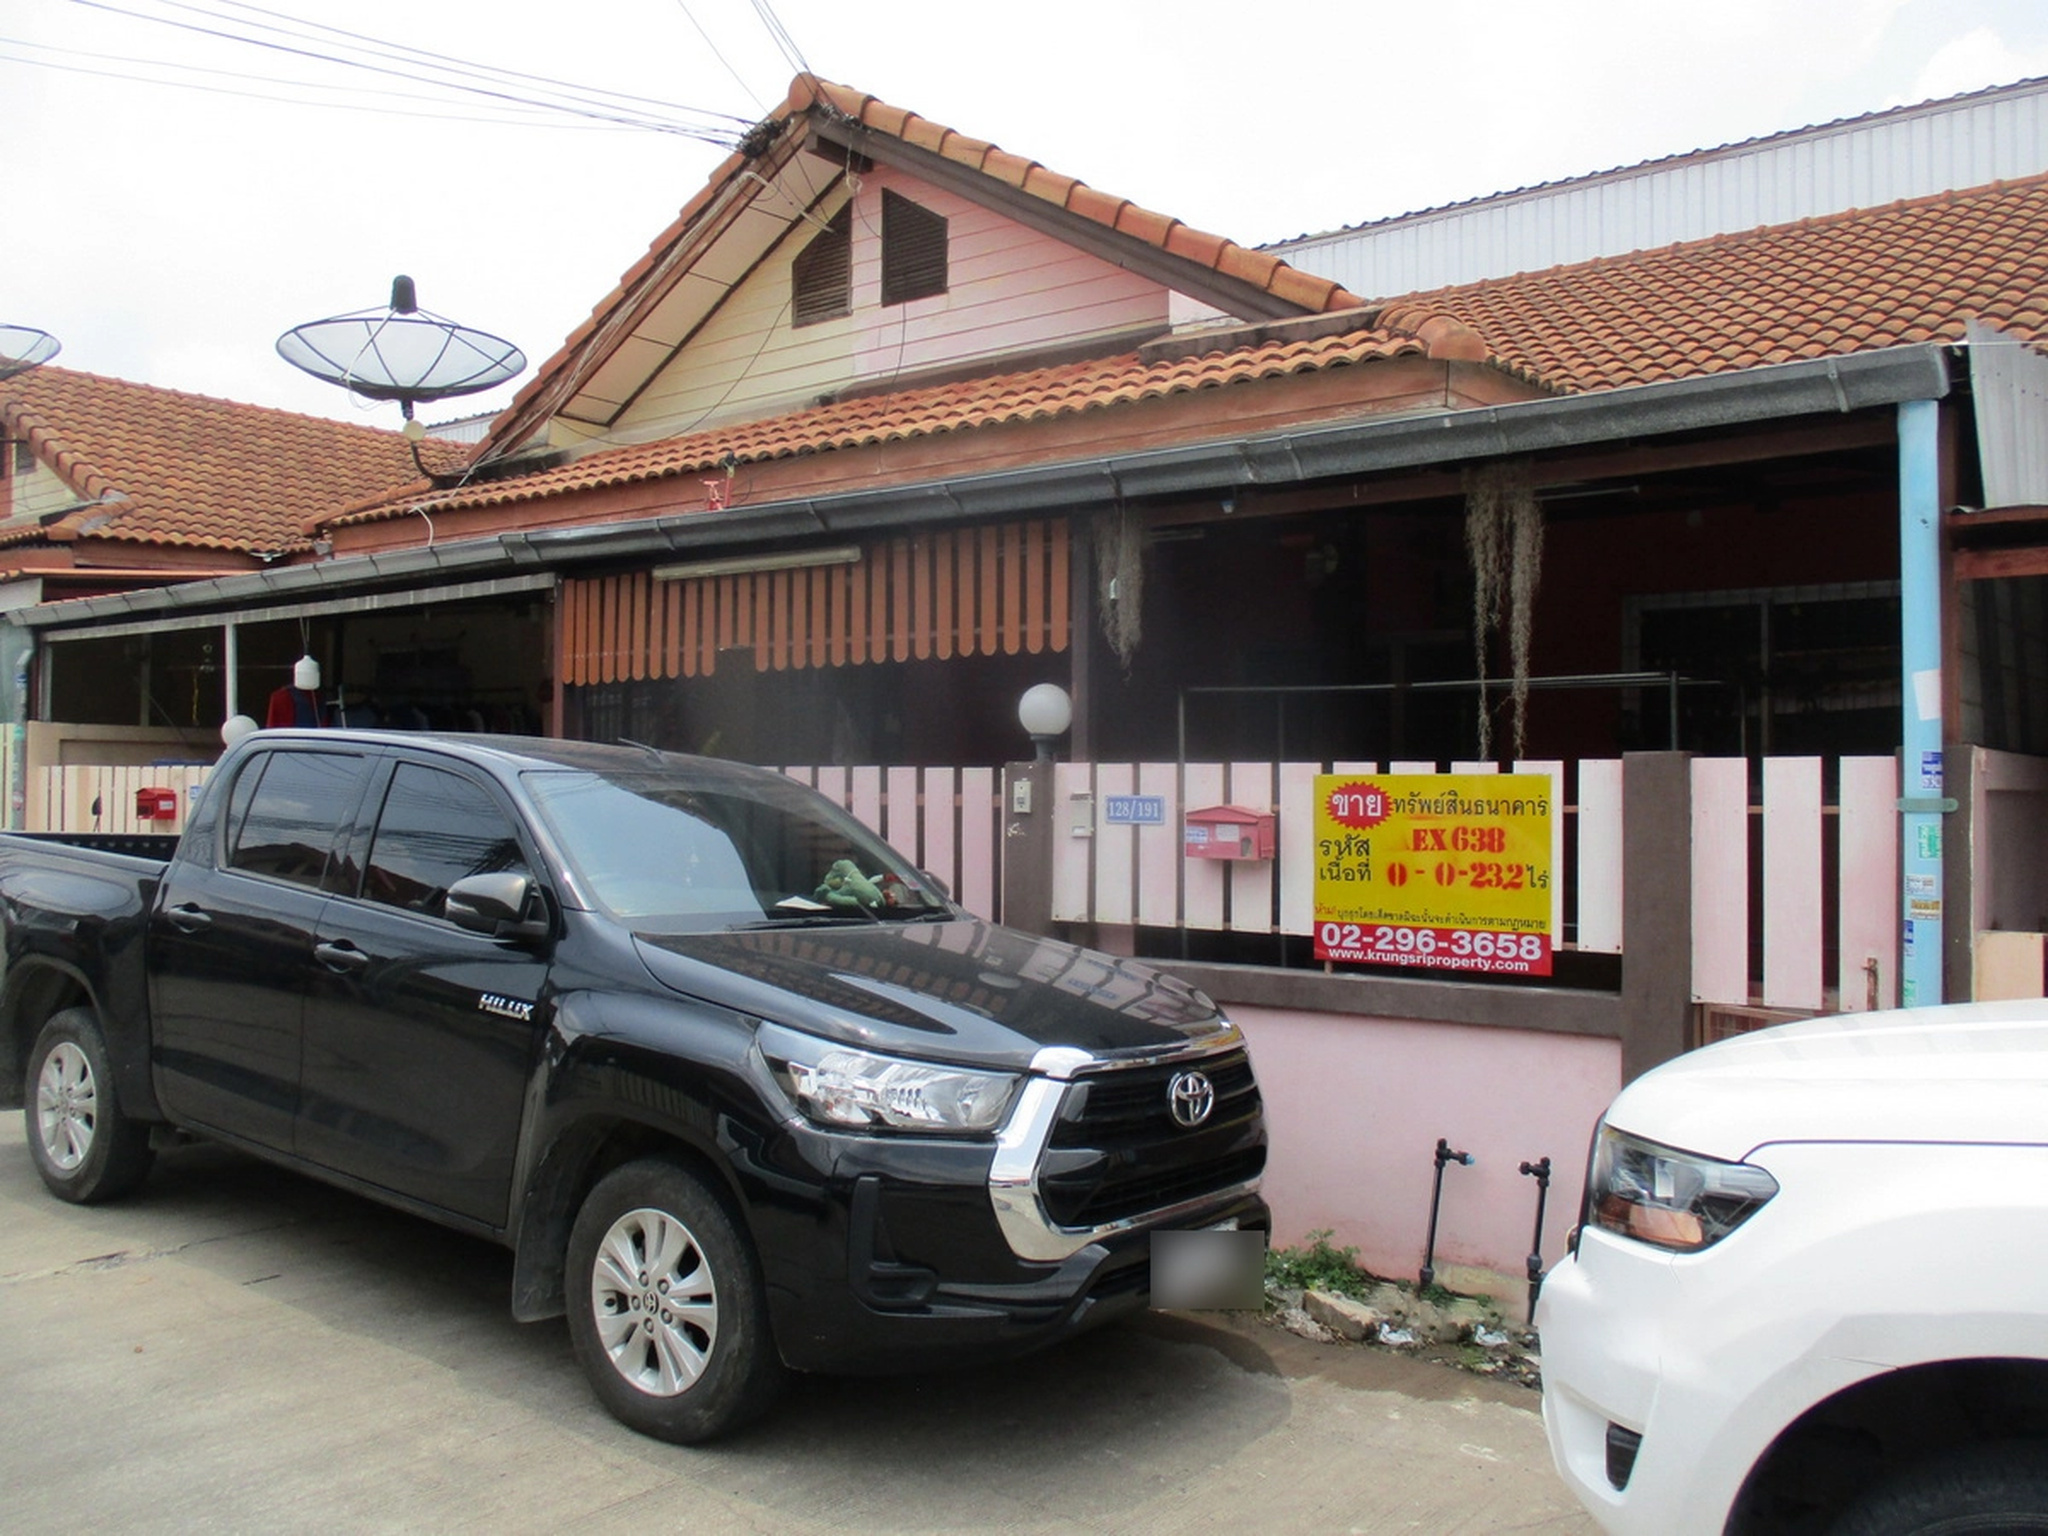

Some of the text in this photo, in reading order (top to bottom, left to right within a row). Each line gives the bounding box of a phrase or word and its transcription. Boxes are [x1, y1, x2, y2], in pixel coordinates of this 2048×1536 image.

[1109, 800, 1159, 819] 128/191
[1332, 793, 1382, 817] ขาย
[1319, 834, 1370, 857] รหัส
[1319, 856, 1371, 881] เนื้อที่
[1526, 864, 1549, 889] ไร่
[1321, 922, 1542, 961] 02-296-3658
[1328, 947, 1529, 972] www.krungsriproperty.com
[477, 993, 534, 1021] HILUX
